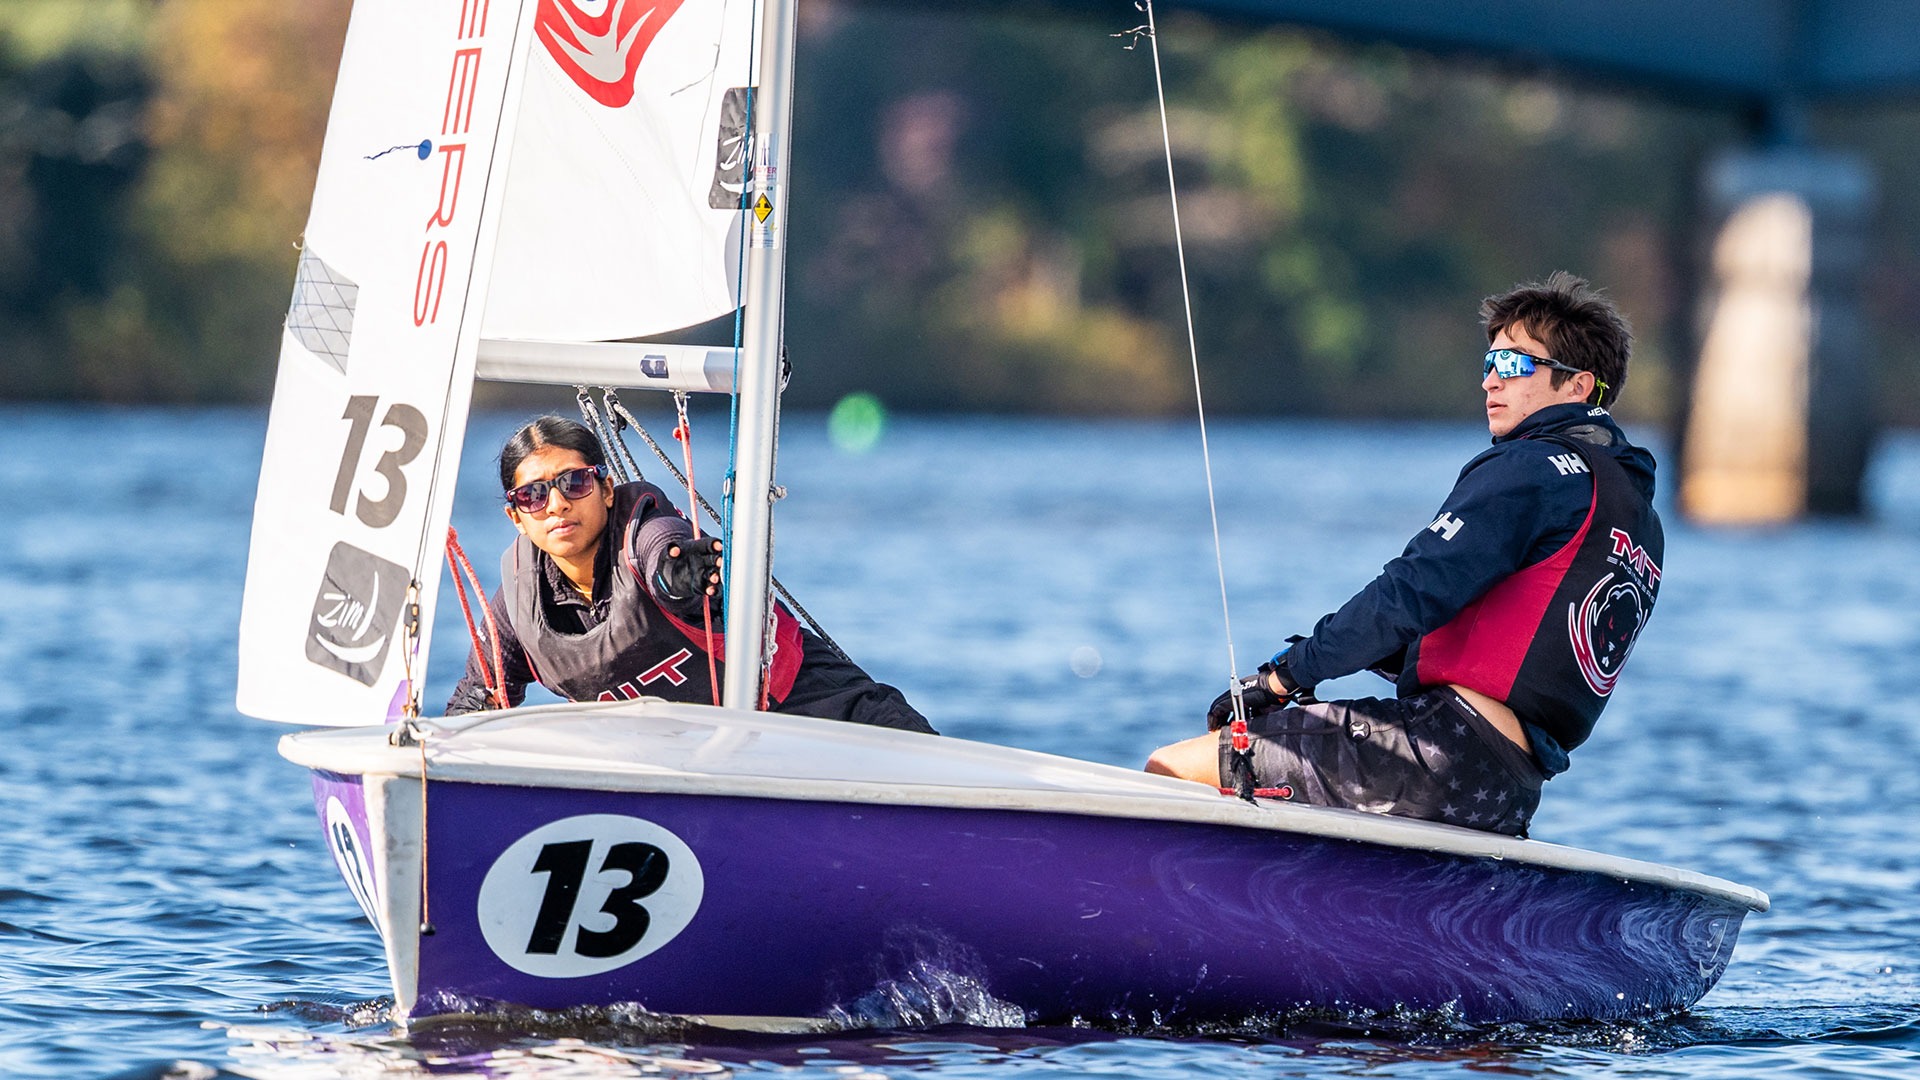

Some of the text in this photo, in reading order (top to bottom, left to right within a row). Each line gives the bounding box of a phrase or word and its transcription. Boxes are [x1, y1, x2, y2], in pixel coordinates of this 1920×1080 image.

[329, 394, 428, 529] 13
[1547, 453, 1590, 476] HH
[1427, 511, 1465, 542] H
[1609, 527, 1662, 590] MIT
[525, 838, 670, 959] 13
